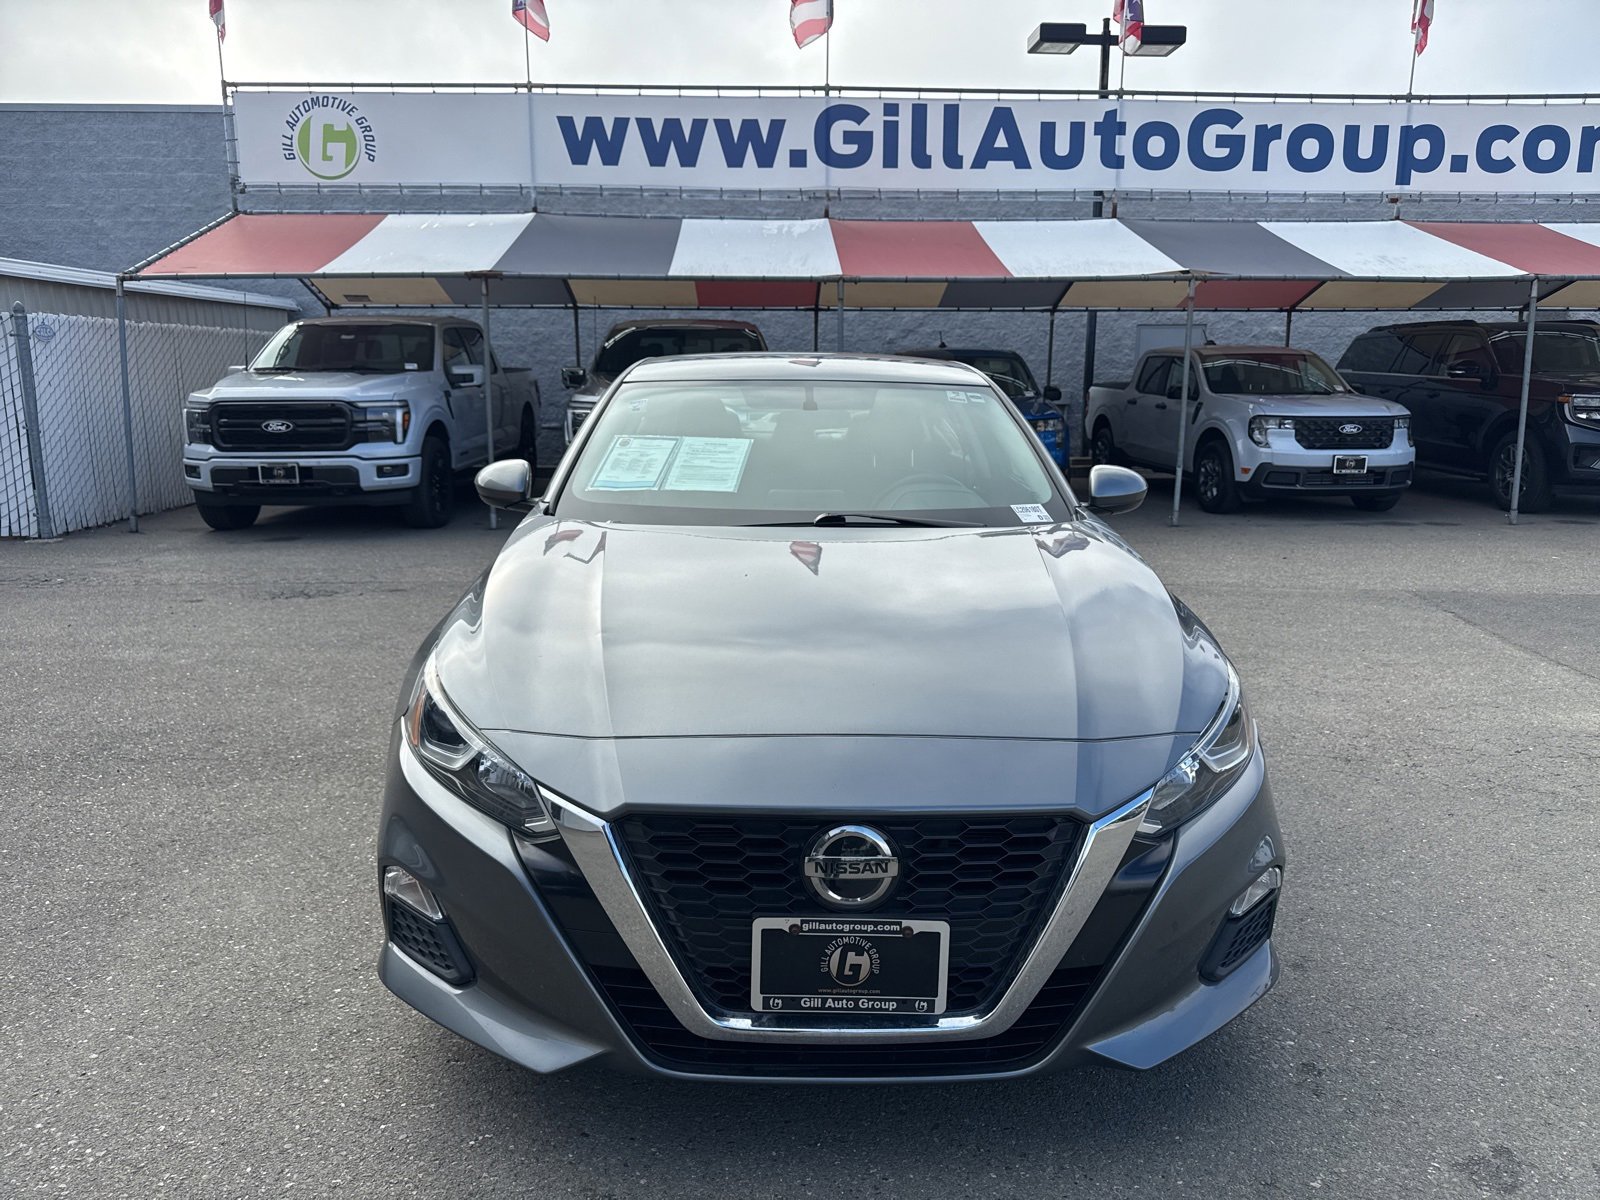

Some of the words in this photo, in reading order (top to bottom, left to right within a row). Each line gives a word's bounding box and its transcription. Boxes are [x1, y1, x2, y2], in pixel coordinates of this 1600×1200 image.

[285, 95, 359, 132] AUTOMOTIVE
[282, 133, 296, 161] GILL
[354, 115, 377, 163] GROUP
[814, 861, 889, 875] NISSAN
[801, 921, 901, 933] gillautogroup.com
[820, 955, 830, 973] GILL
[826, 936, 873, 957] AUTOMOTIVE
[868, 947, 881, 974] GROUP
[817, 987, 881, 995] www.gillautogroup.com
[800, 997, 822, 1009] Gill
[824, 998, 855, 1010] Auto
[858, 999, 898, 1011] Group
